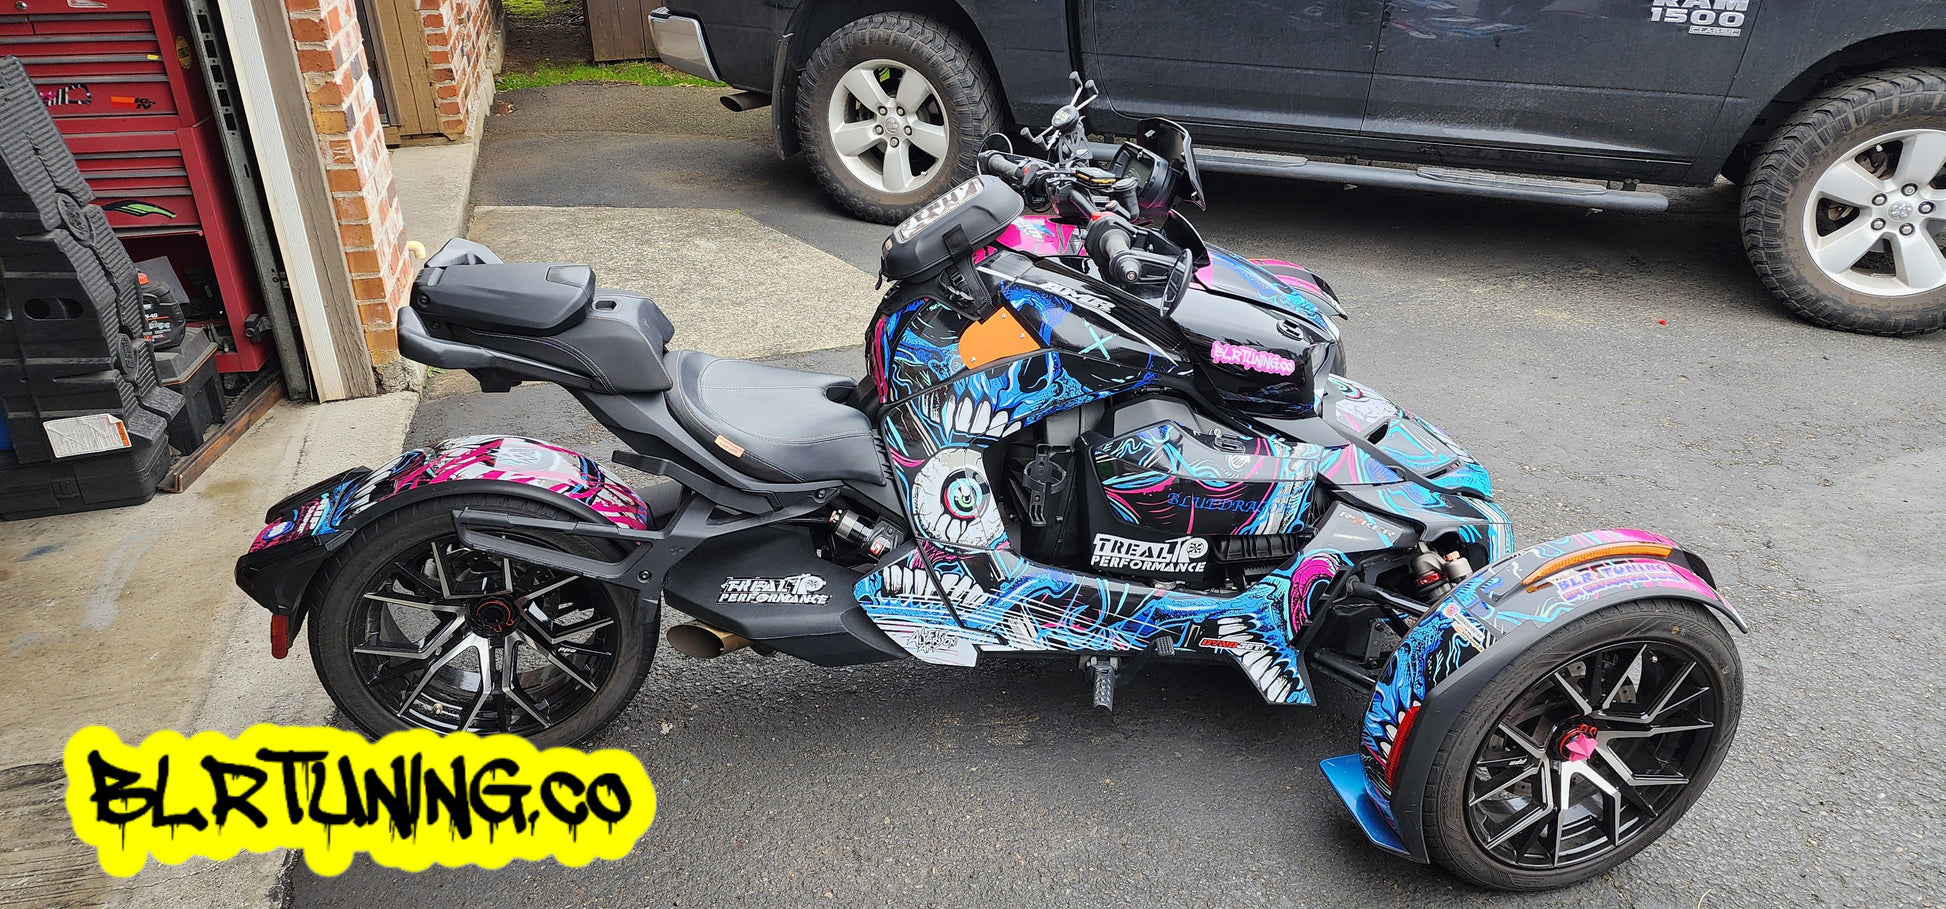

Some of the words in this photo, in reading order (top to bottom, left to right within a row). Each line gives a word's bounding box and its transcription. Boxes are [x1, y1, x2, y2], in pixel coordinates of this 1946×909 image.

[1651, 8, 1745, 27] 1500
[1091, 555, 1207, 573] PERFORMANCE
[1557, 572, 1593, 591] BLR
[1600, 563, 1667, 578] TUNING
[718, 593, 830, 605] PERFORMANCE
